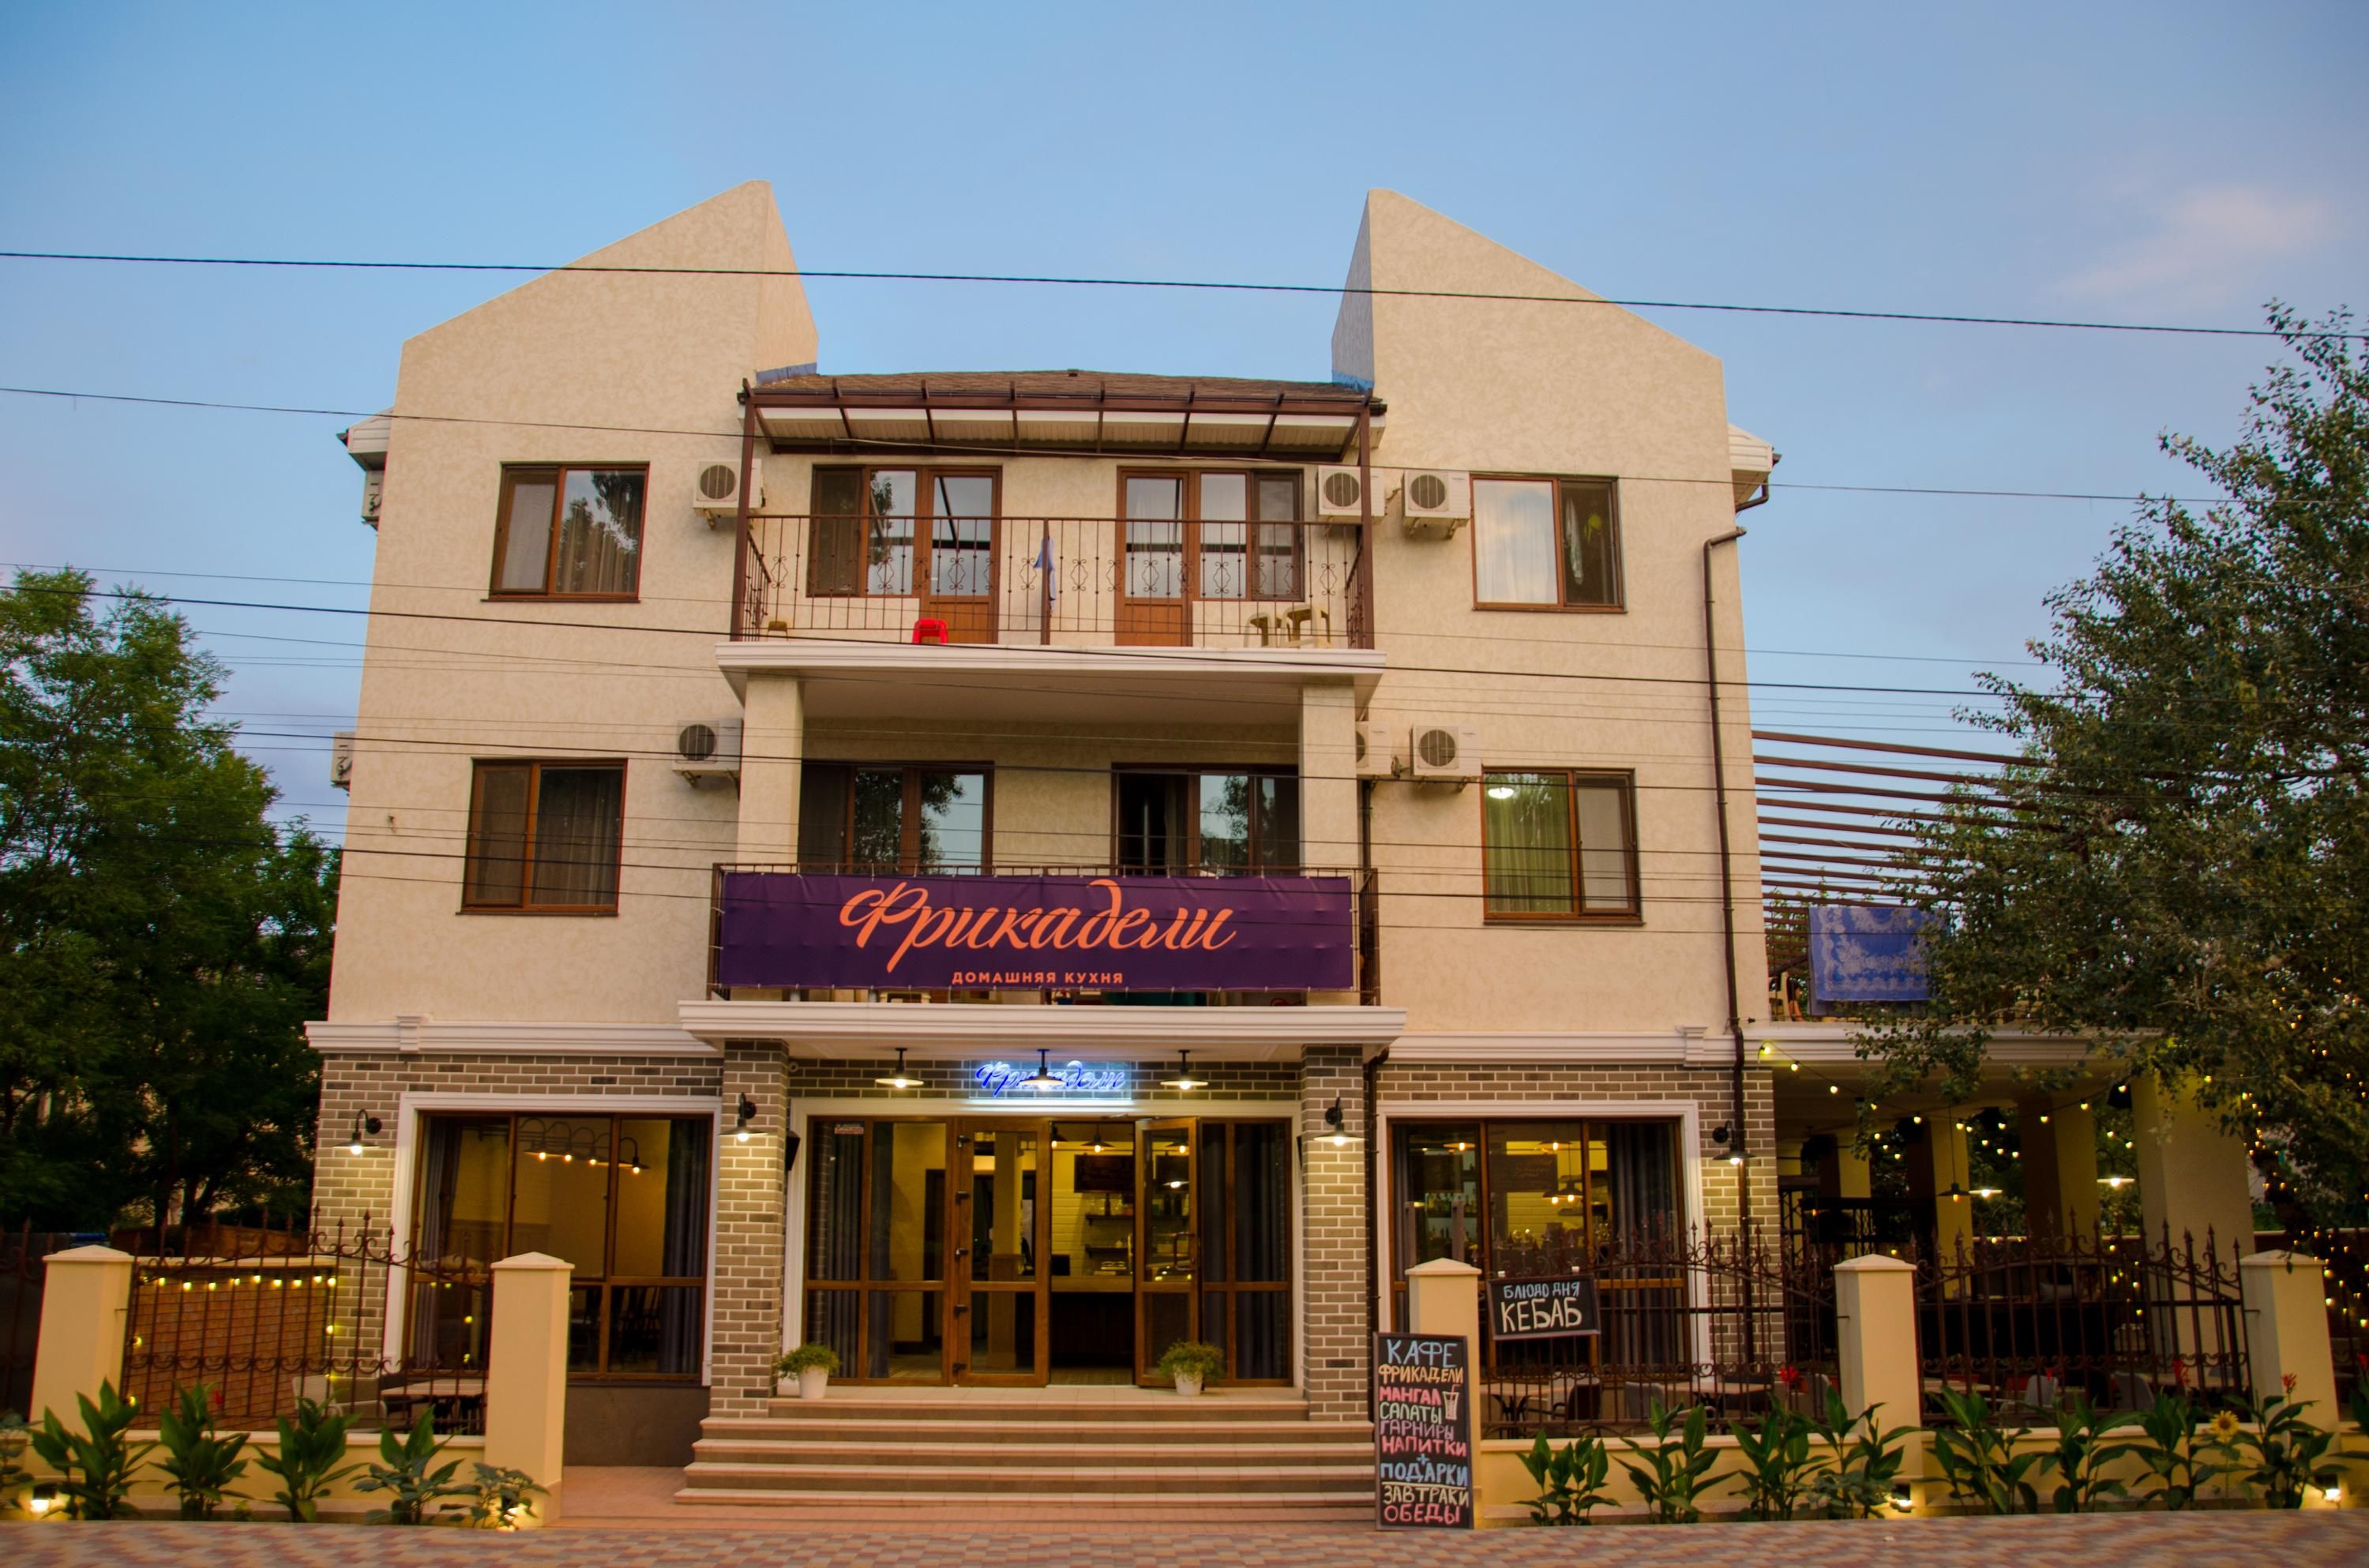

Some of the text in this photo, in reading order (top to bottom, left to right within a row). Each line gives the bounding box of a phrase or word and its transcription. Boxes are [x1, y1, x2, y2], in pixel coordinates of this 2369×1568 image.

[839, 878, 1237, 973] Фрикадели
[952, 972, 1123, 985] ДОМАШНЯЯ КУХНЯ
[1504, 1281, 1580, 1299] БЛЮДО ДНЯ
[1500, 1296, 1582, 1333] КЕБАБ
[1387, 1338, 1458, 1367] КАФЕ
[1378, 1364, 1464, 1384] ФРИКАДЕЛИ
[1379, 1386, 1442, 1405] МАНГАЛ
[1380, 1401, 1442, 1424] САЛАТЫ
[1380, 1419, 1454, 1441] ГАРНИРЫ
[1382, 1435, 1466, 1457] НАПИТКИ
[1380, 1462, 1468, 1487] ПОДАРКИ
[1383, 1485, 1469, 1508] ЗАВТРАКИ
[1383, 1503, 1460, 1525] ОБЕДЫ
